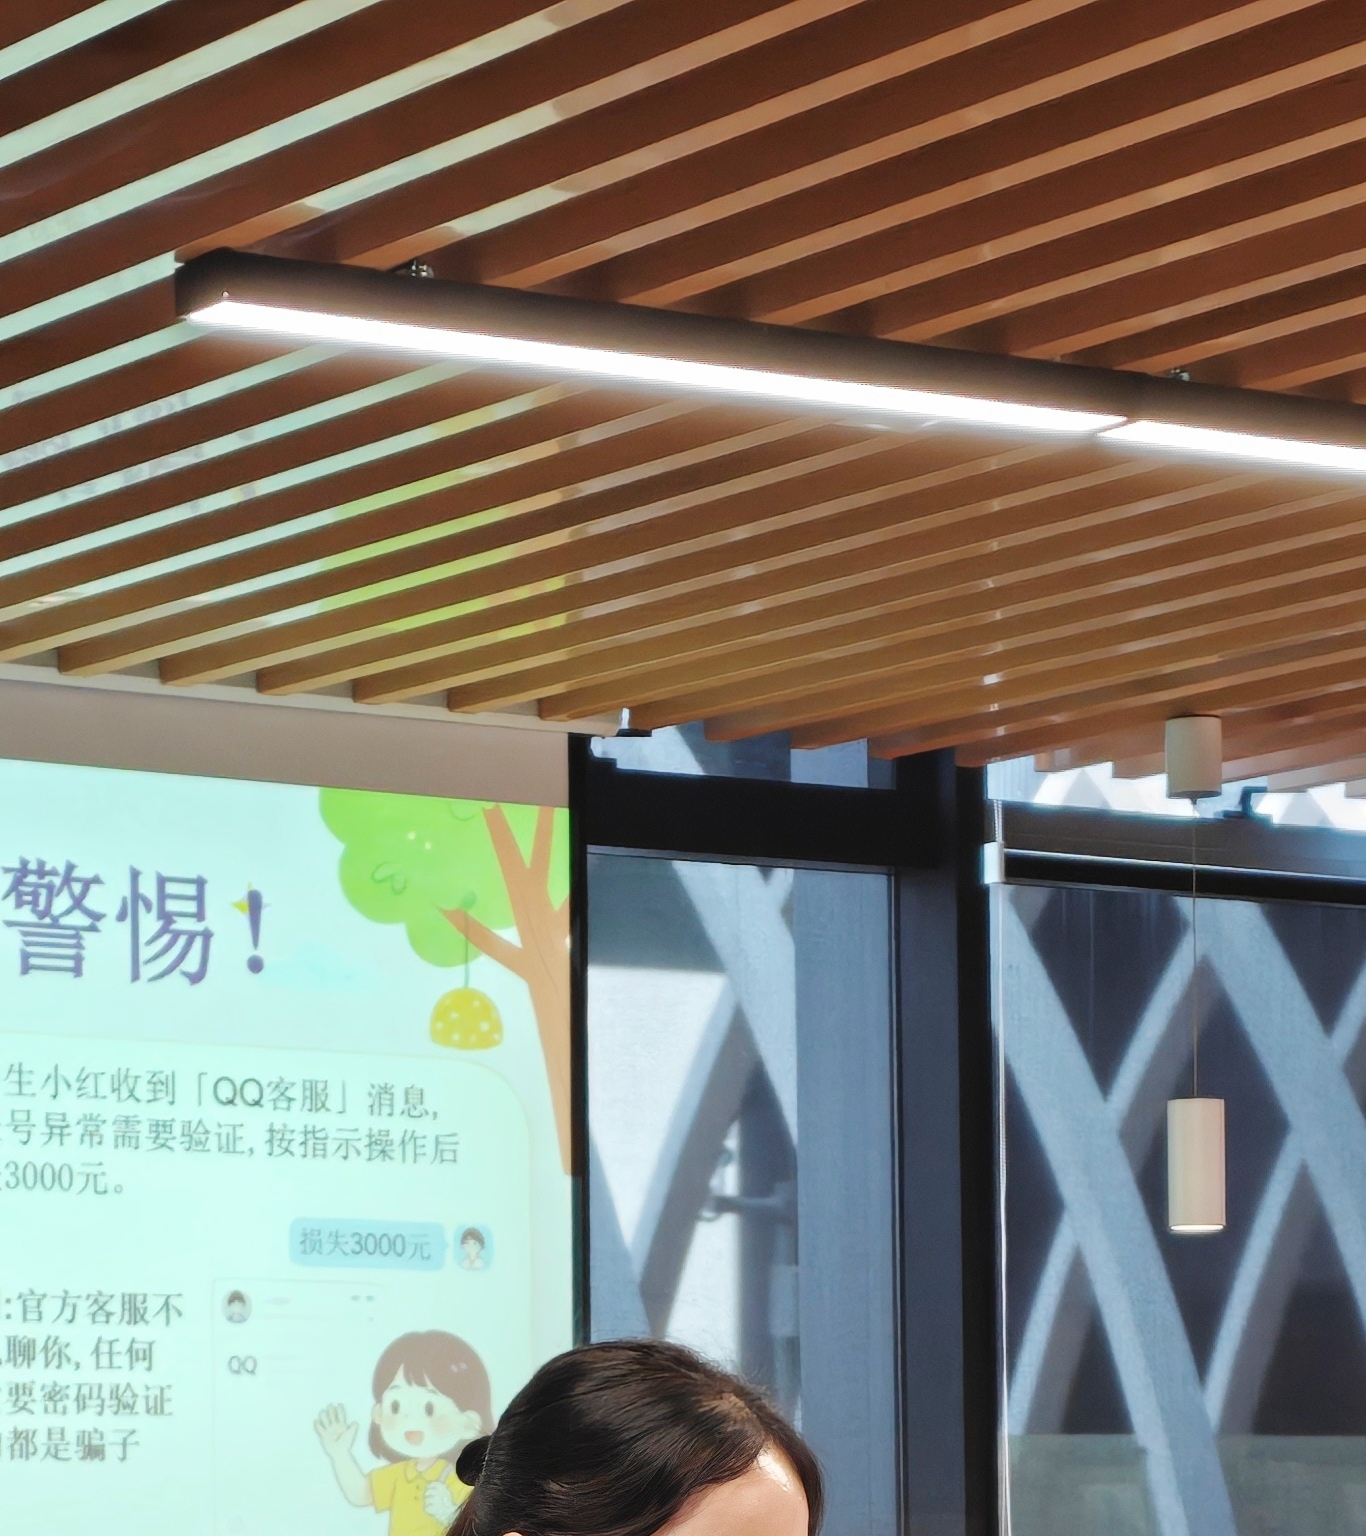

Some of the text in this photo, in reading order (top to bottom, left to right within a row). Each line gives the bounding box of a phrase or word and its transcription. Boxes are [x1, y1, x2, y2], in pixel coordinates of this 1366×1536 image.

[299, 1226, 432, 1262] 损失3000元
[227, 1353, 258, 1377] QQ
